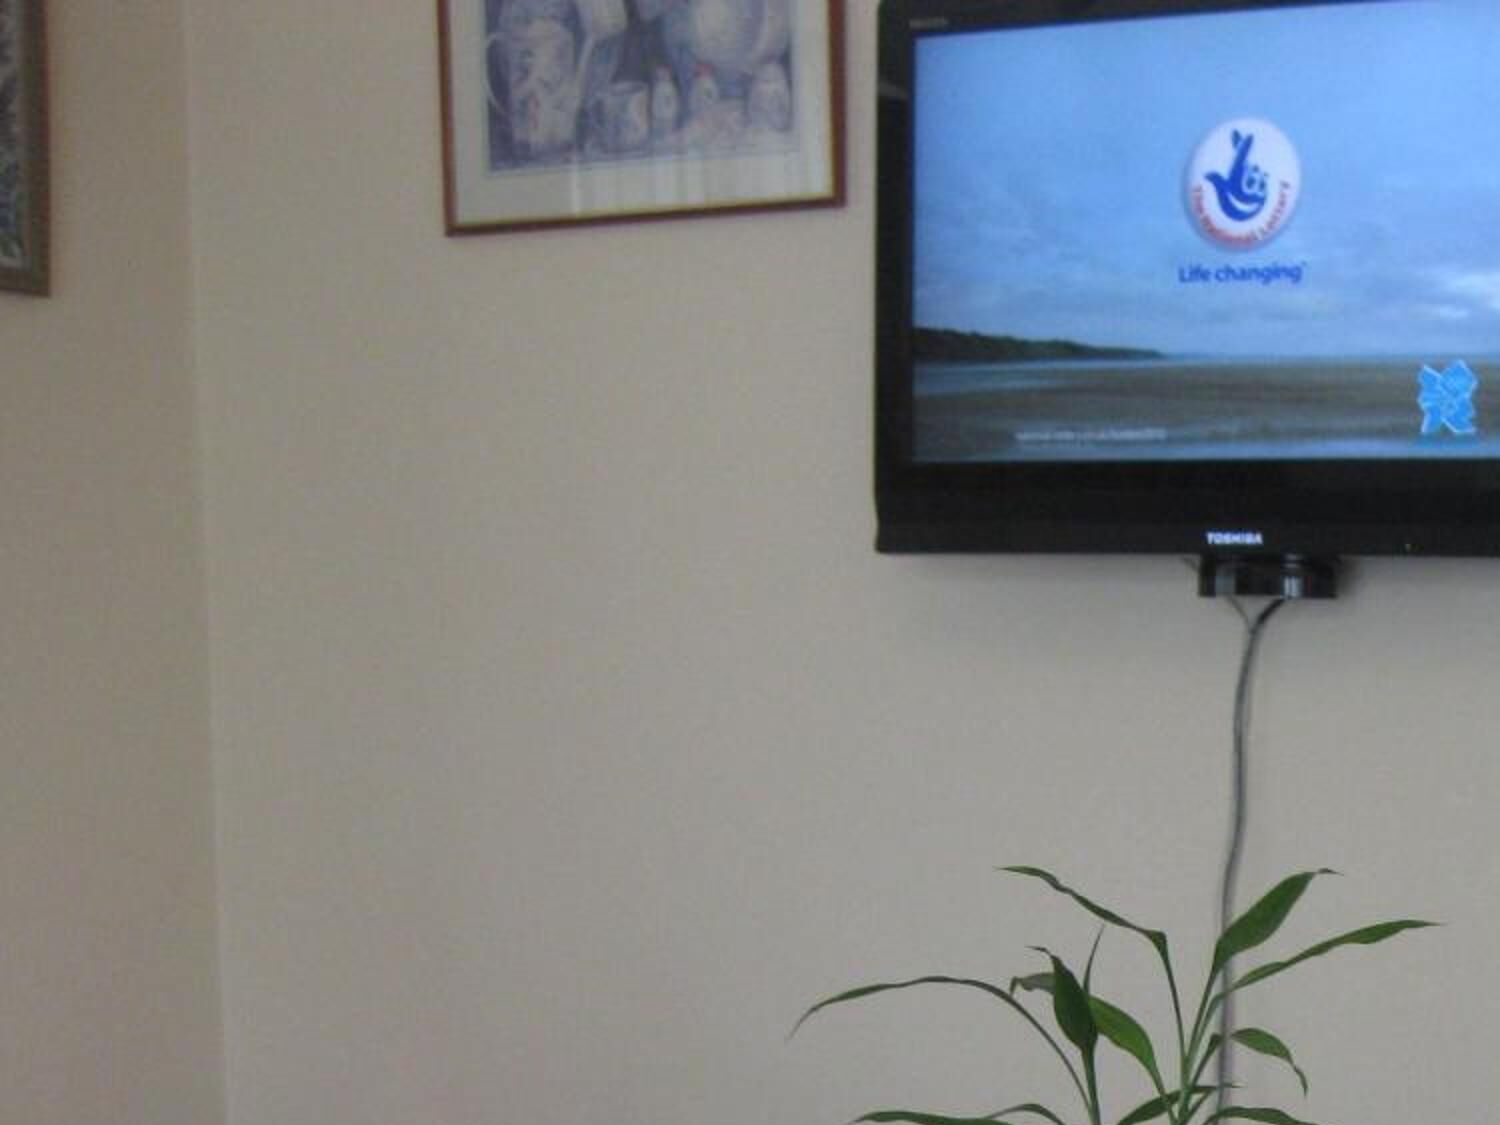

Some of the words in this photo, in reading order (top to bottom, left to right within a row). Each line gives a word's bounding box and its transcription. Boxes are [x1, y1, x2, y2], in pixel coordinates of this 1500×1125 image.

[1178, 264, 1211, 283] Life
[1214, 262, 1303, 286] changing
[1206, 531, 1264, 545] TOSHIBA
